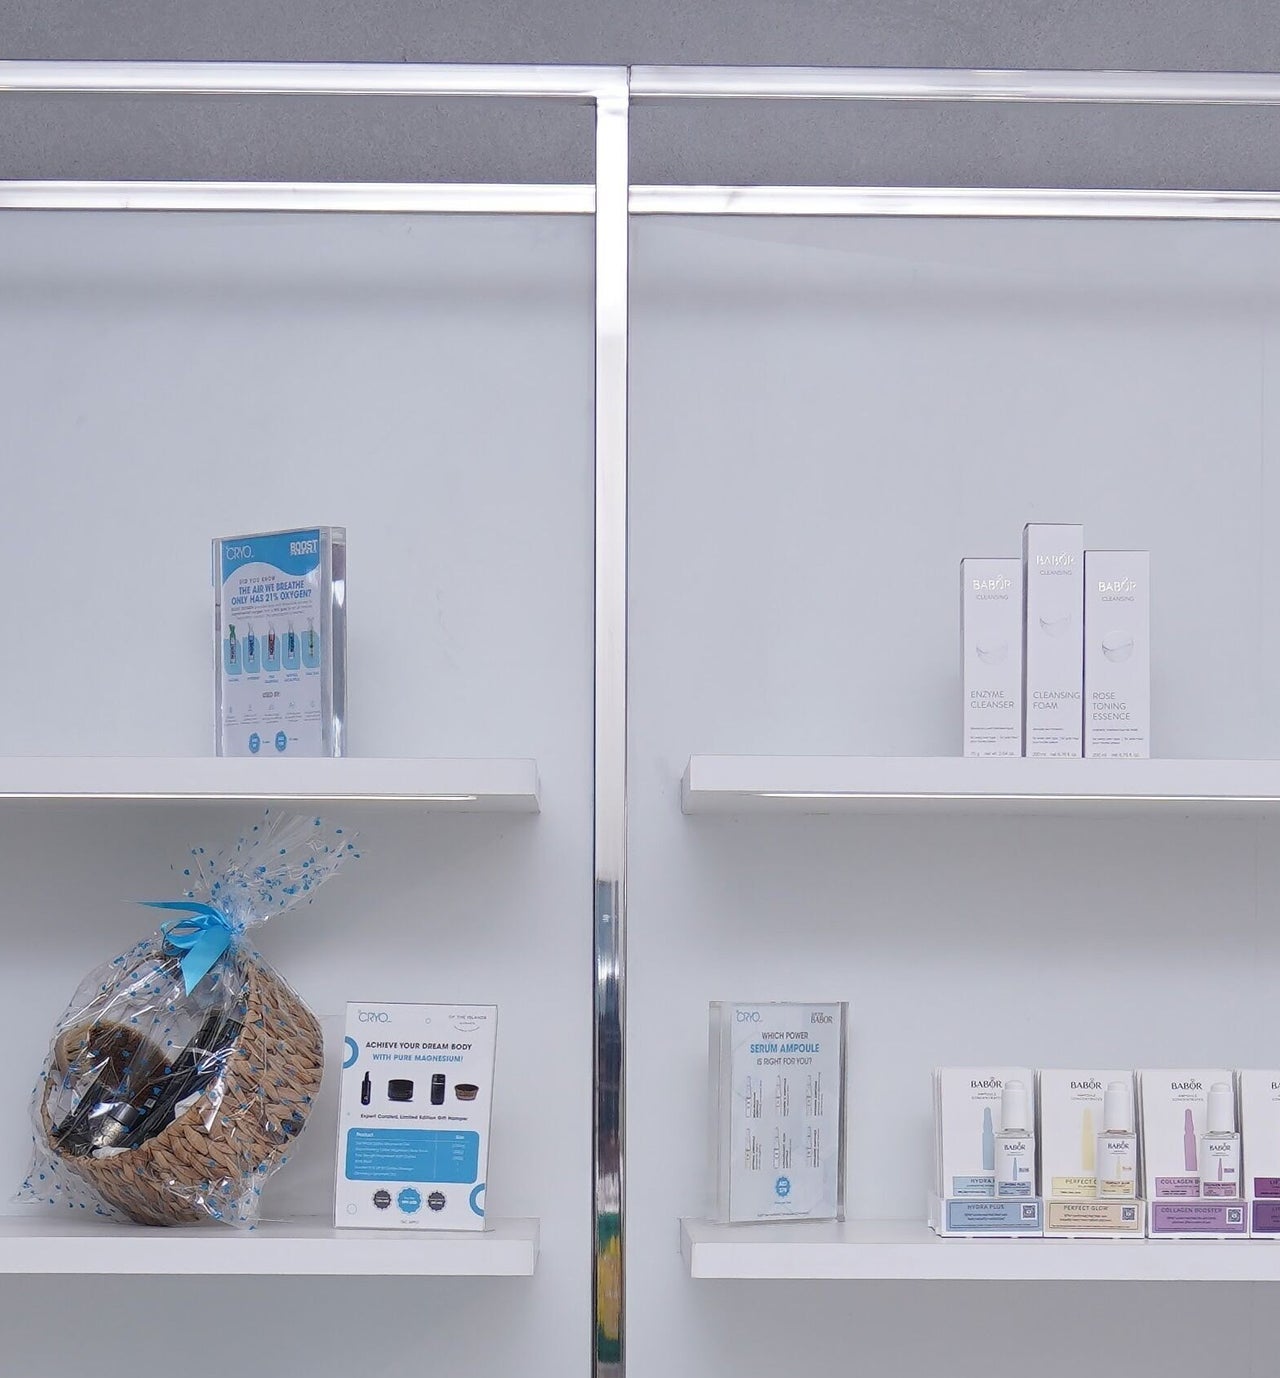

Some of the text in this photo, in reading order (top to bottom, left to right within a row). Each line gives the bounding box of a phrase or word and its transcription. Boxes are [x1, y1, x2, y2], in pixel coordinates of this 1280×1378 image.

[239, 581, 304, 595] THE AIR WE BREATHE
[232, 590, 311, 605] ONLY HAS 21% OXYGEN?
[1093, 692, 1115, 700] ROSE
[971, 701, 1014, 709] CLEANSER
[751, 1044, 819, 1053] SERUM AMPOULE
[971, 1080, 1002, 1088] BABOR
[1172, 1082, 1202, 1090] BABOR
